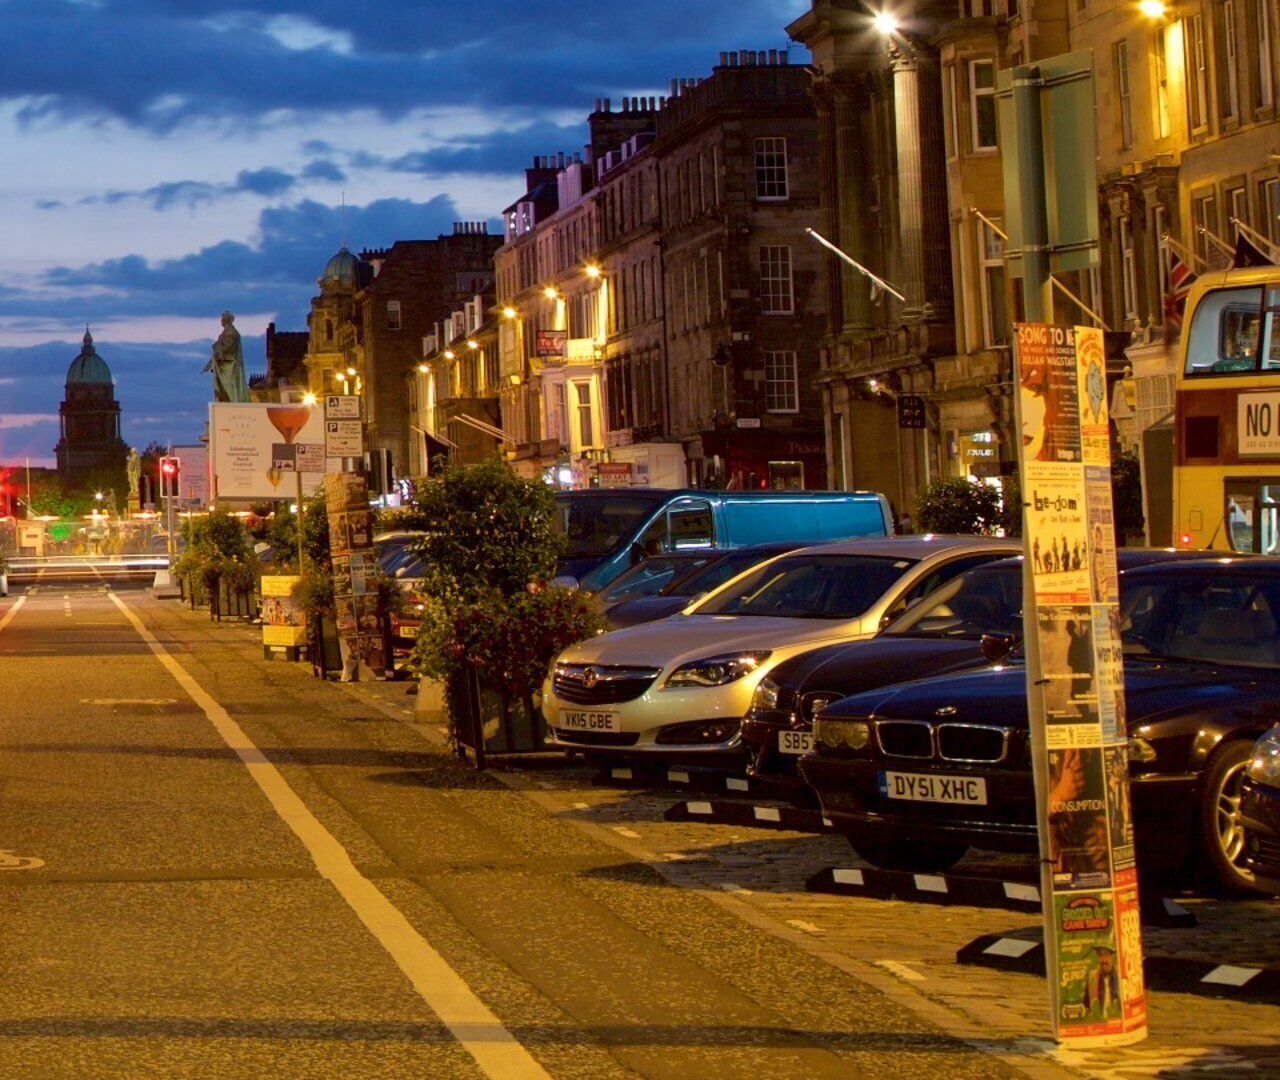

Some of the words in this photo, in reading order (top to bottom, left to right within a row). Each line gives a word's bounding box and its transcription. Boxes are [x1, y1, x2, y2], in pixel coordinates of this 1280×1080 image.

[1019, 327, 1046, 344] SONG
[1049, 328, 1063, 345] TO
[1246, 402, 1271, 437] NO
[589, 714, 613, 729] GBE
[895, 775, 934, 797] DY51
[940, 779, 978, 801] XHC
[1051, 799, 1107, 813] CONSUMPTION
